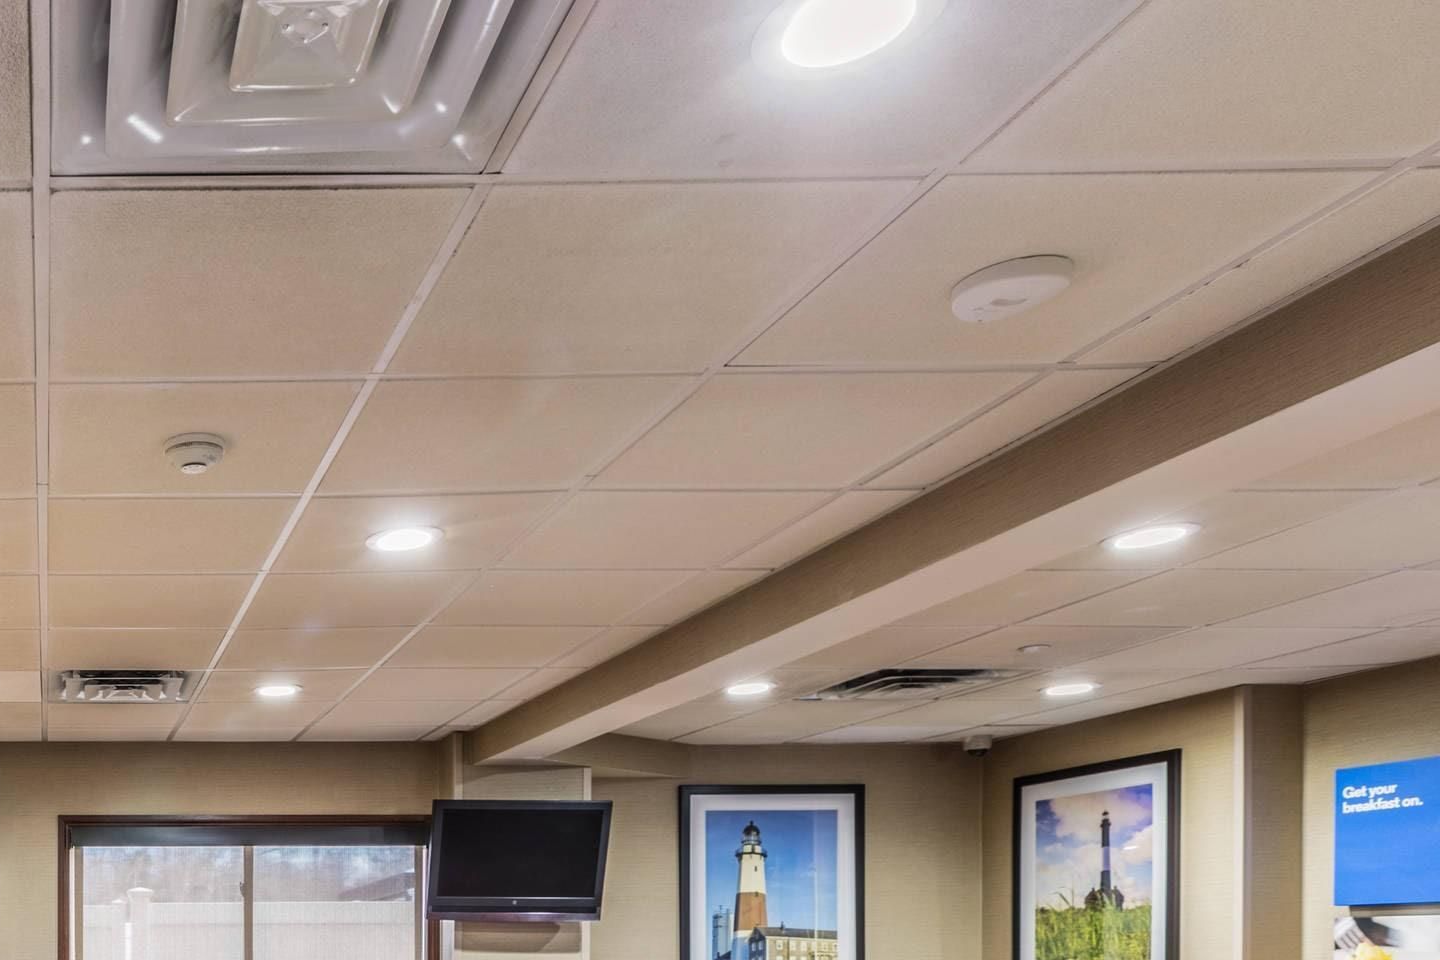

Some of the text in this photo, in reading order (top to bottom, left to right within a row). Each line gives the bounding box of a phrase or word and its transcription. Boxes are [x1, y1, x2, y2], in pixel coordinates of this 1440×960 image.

[1342, 784, 1398, 799] Get your
[1342, 796, 1424, 814] breakfast on.
